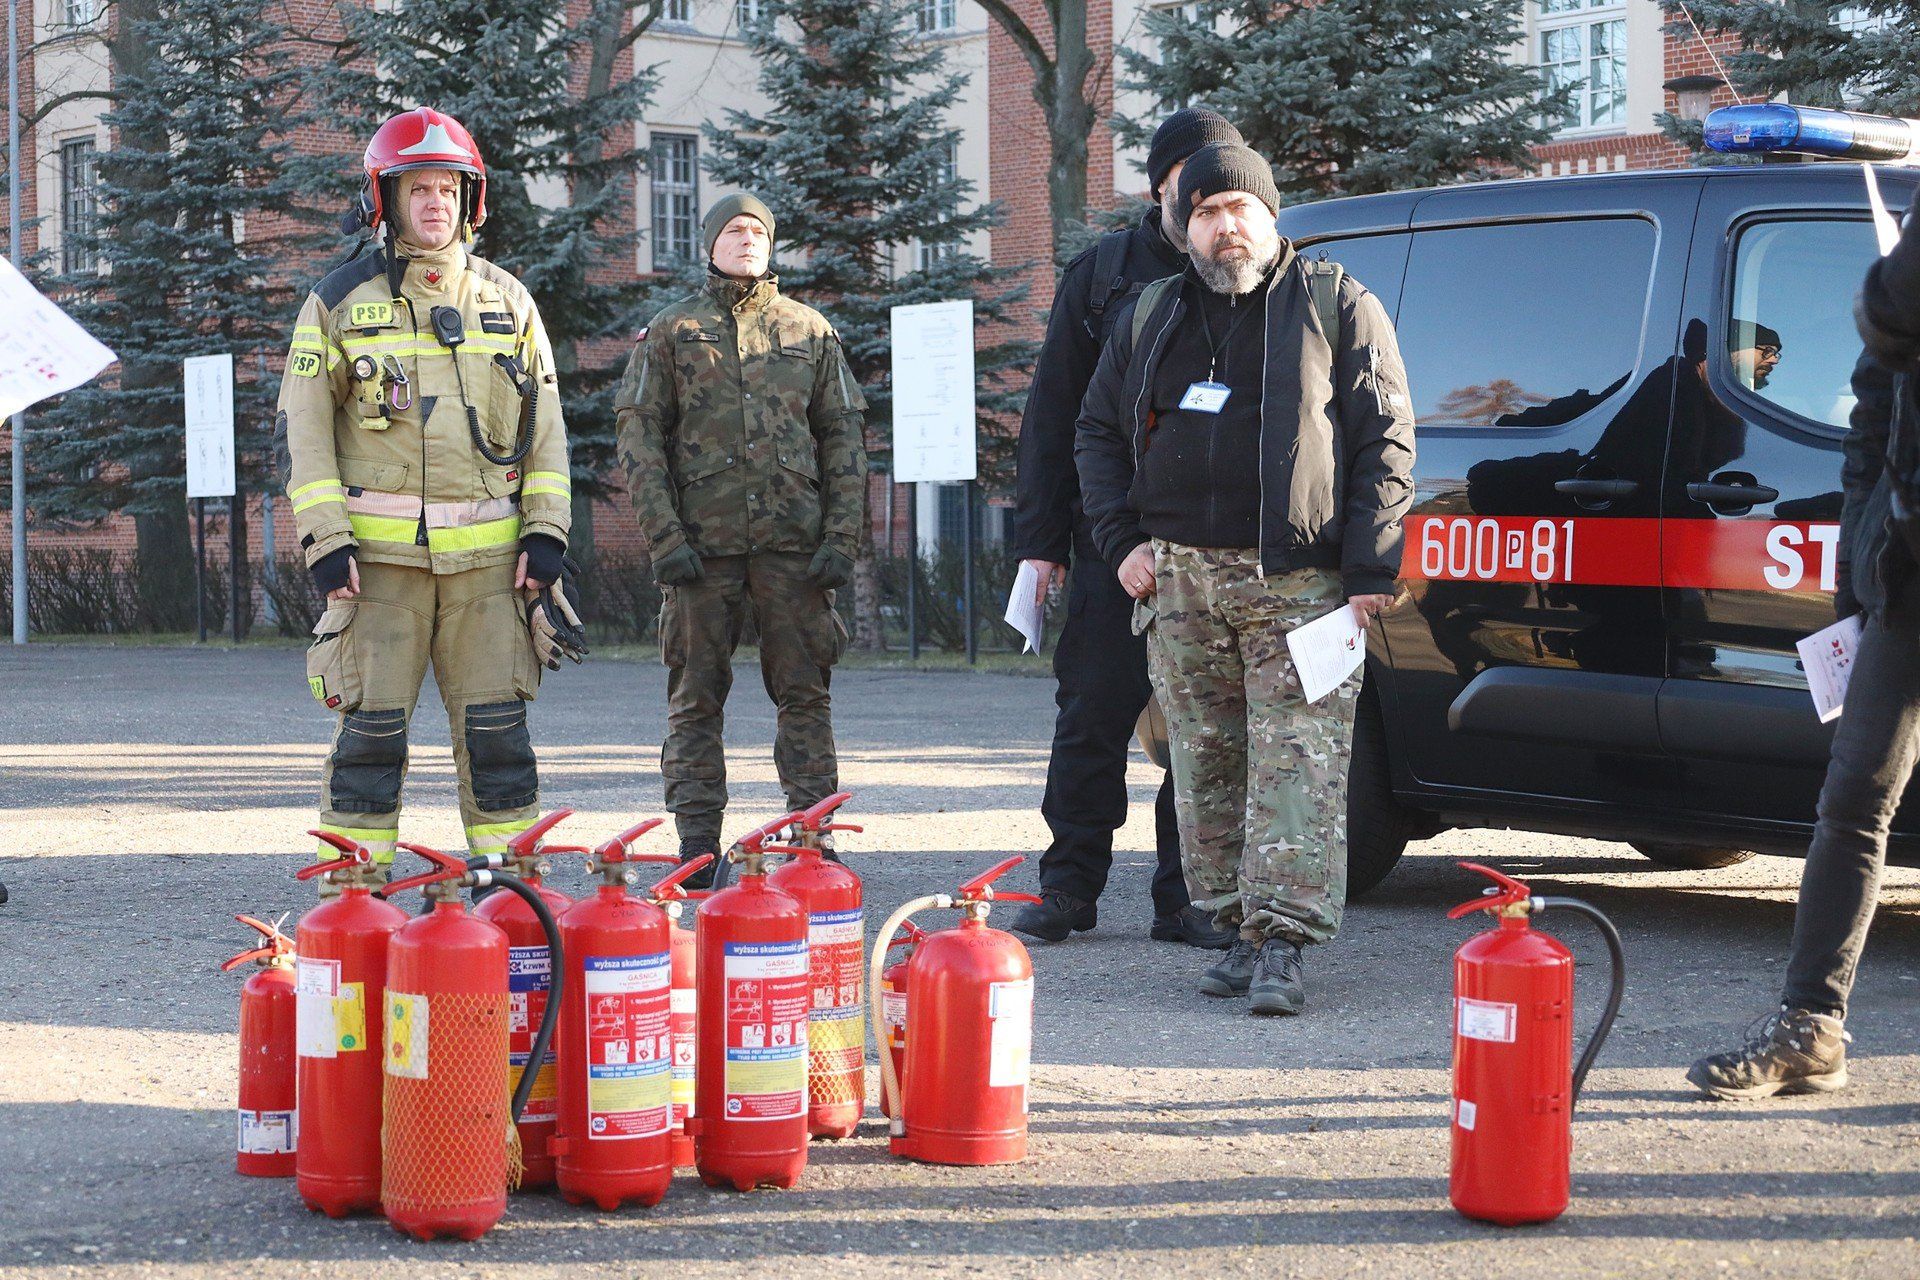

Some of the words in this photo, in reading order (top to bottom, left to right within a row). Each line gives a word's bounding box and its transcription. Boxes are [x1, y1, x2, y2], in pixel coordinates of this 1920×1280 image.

[356, 306, 387, 320] PSP
[292, 355, 316, 372] PSP
[375, 390, 382, 401] 6
[808, 914, 826, 924] yższa
[510, 951, 531, 959] YŻSZA
[733, 944, 759, 955] wyższa
[594, 959, 621, 970] wyższa
[621, 956, 659, 968] skuteczność
[754, 1024, 764, 1035] A
[618, 1040, 628, 1051] A
